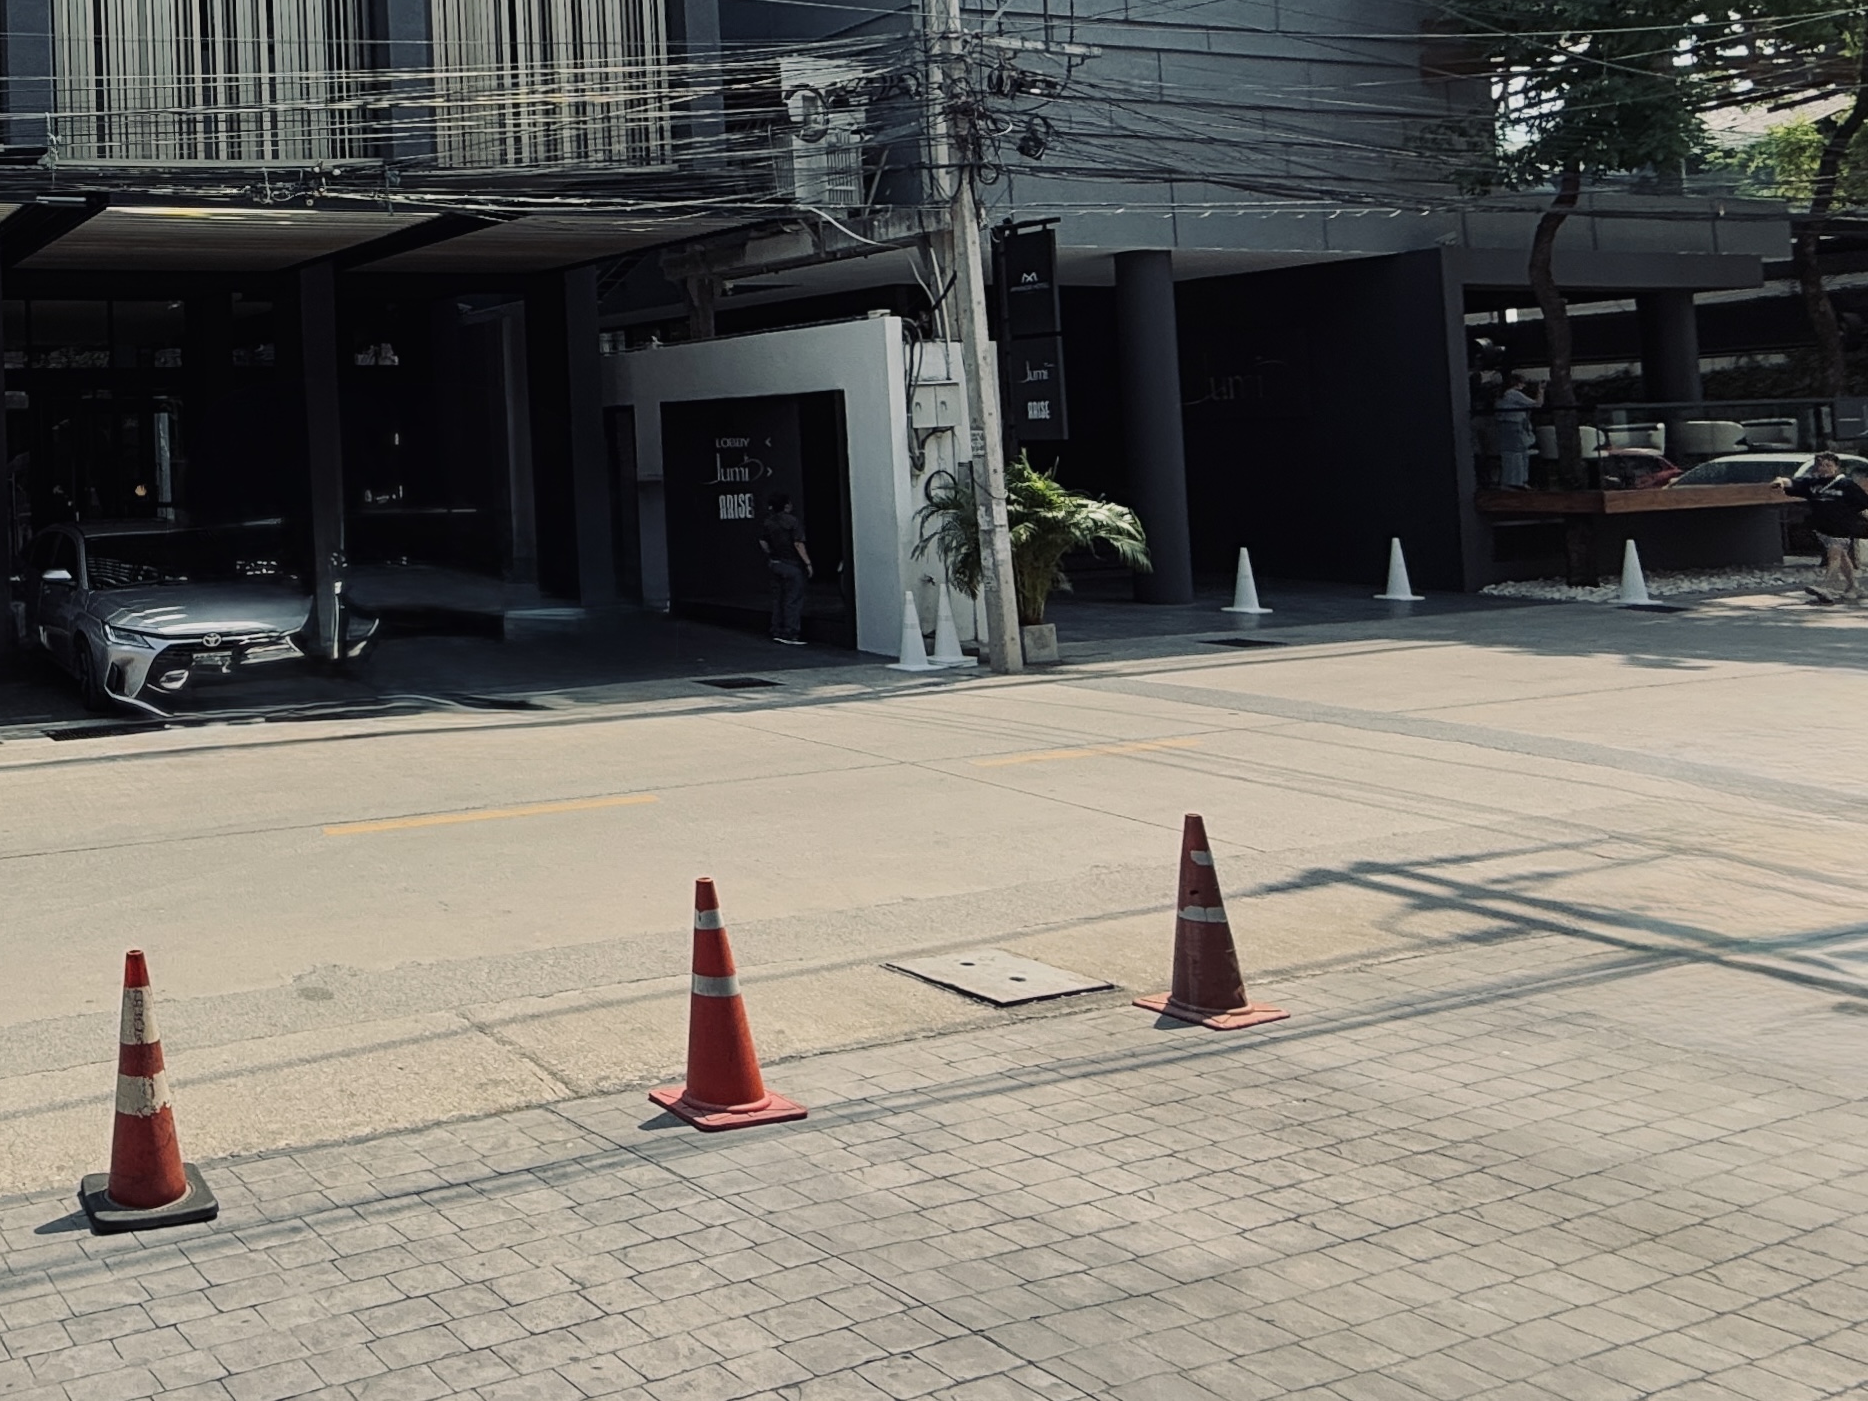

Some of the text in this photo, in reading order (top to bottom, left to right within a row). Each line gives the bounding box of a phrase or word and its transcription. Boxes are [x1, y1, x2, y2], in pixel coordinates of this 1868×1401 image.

[1027, 400, 1051, 420] ARISE
[715, 437, 751, 448] LOBBY
[718, 492, 755, 520] ARISE
